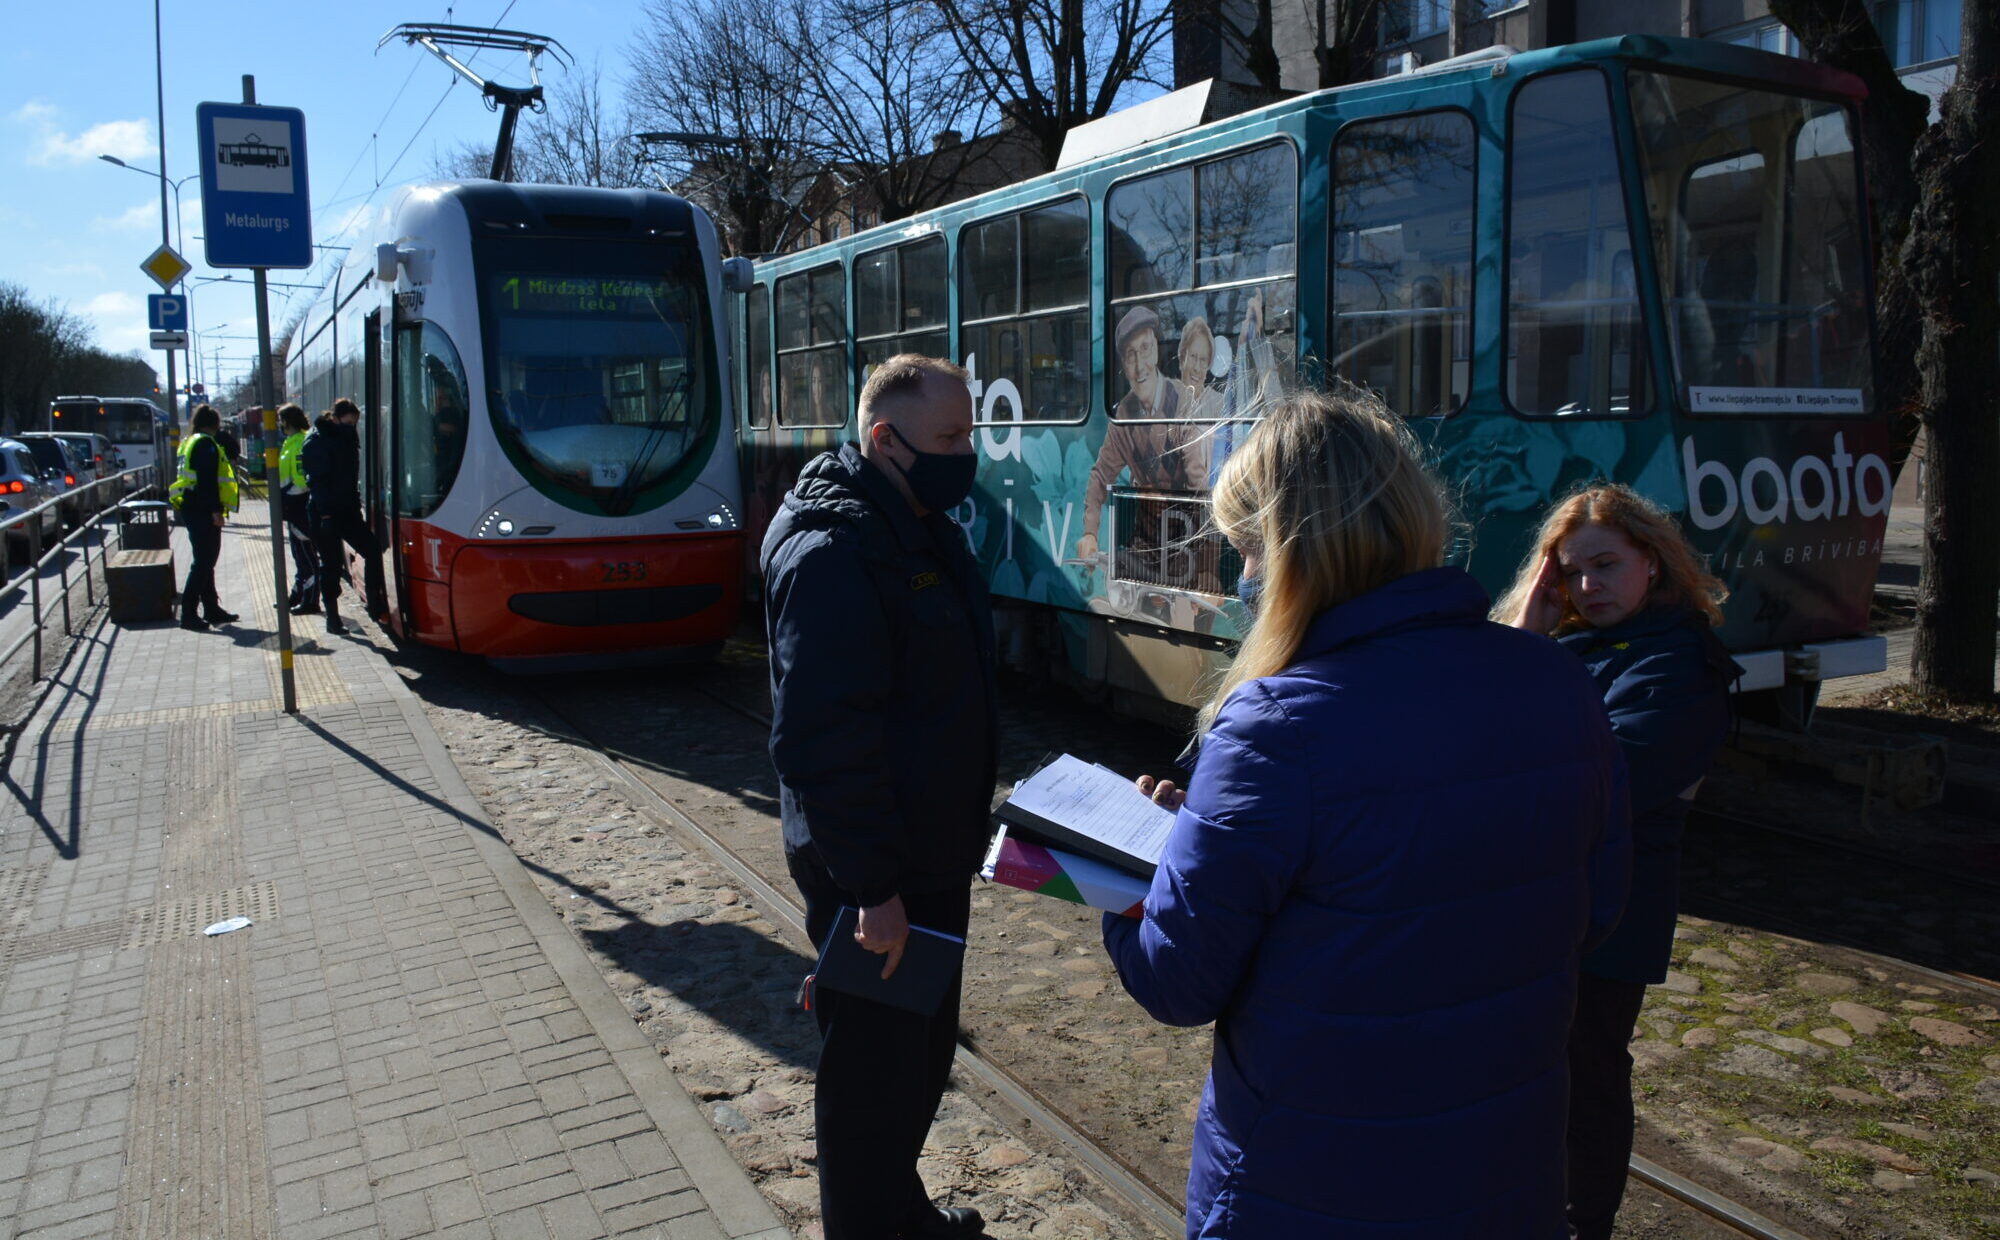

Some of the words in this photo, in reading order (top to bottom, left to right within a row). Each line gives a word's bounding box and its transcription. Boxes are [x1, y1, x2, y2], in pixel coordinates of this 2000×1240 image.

[225, 211, 289, 232] Metalurgs
[502, 278, 519, 310] 1
[528, 280, 595, 296] Mirdzas
[158, 297, 181, 327] P
[1682, 430, 1894, 531] baata
[602, 561, 647, 583] 253
